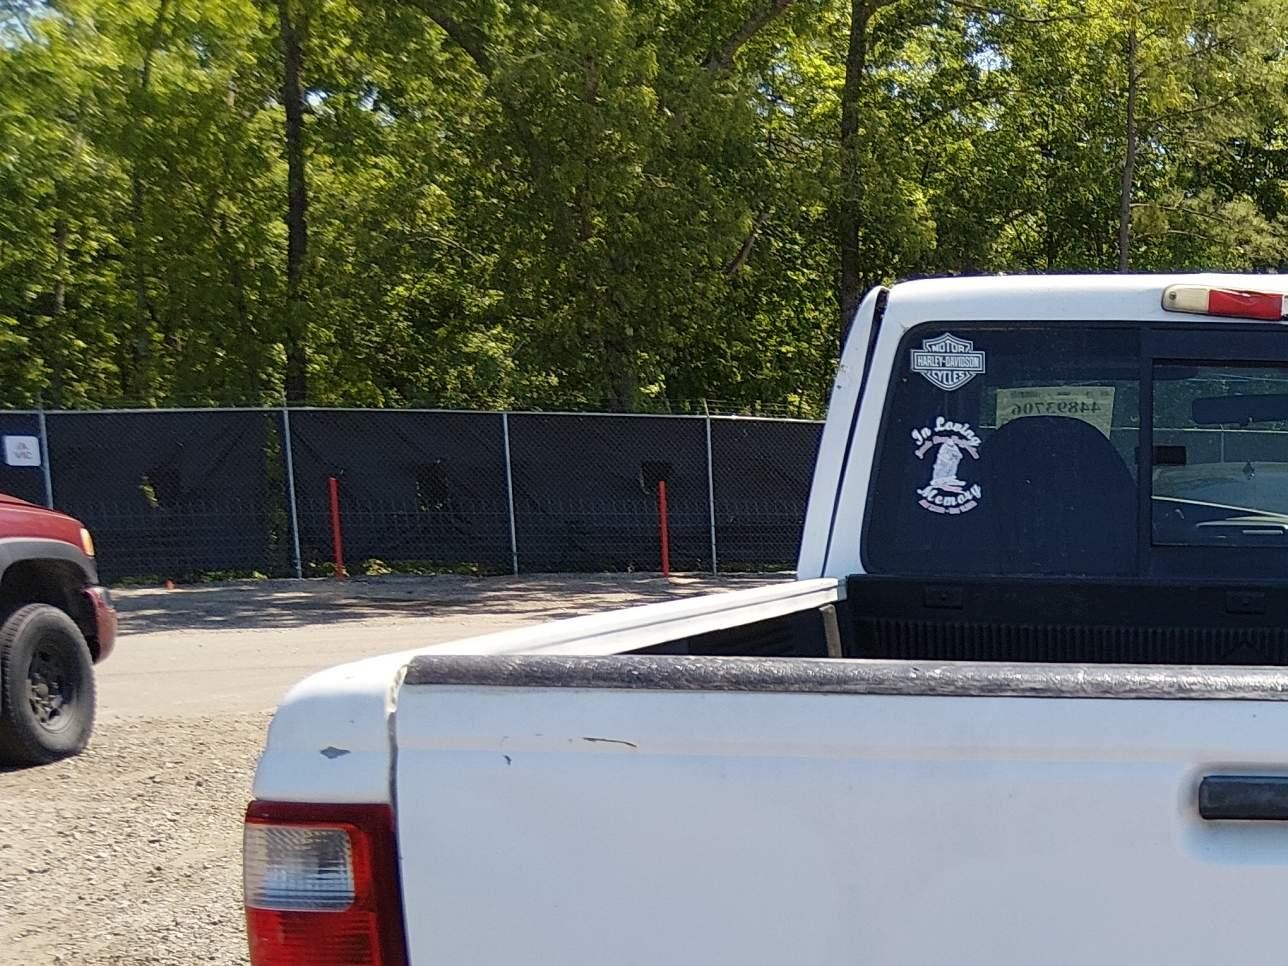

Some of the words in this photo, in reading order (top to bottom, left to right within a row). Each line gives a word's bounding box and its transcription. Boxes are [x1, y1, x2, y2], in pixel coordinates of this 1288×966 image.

[932, 341, 965, 353] MOTOR
[917, 355, 980, 368] HARLEY-DAVIDSON
[931, 370, 966, 385] CYCLES
